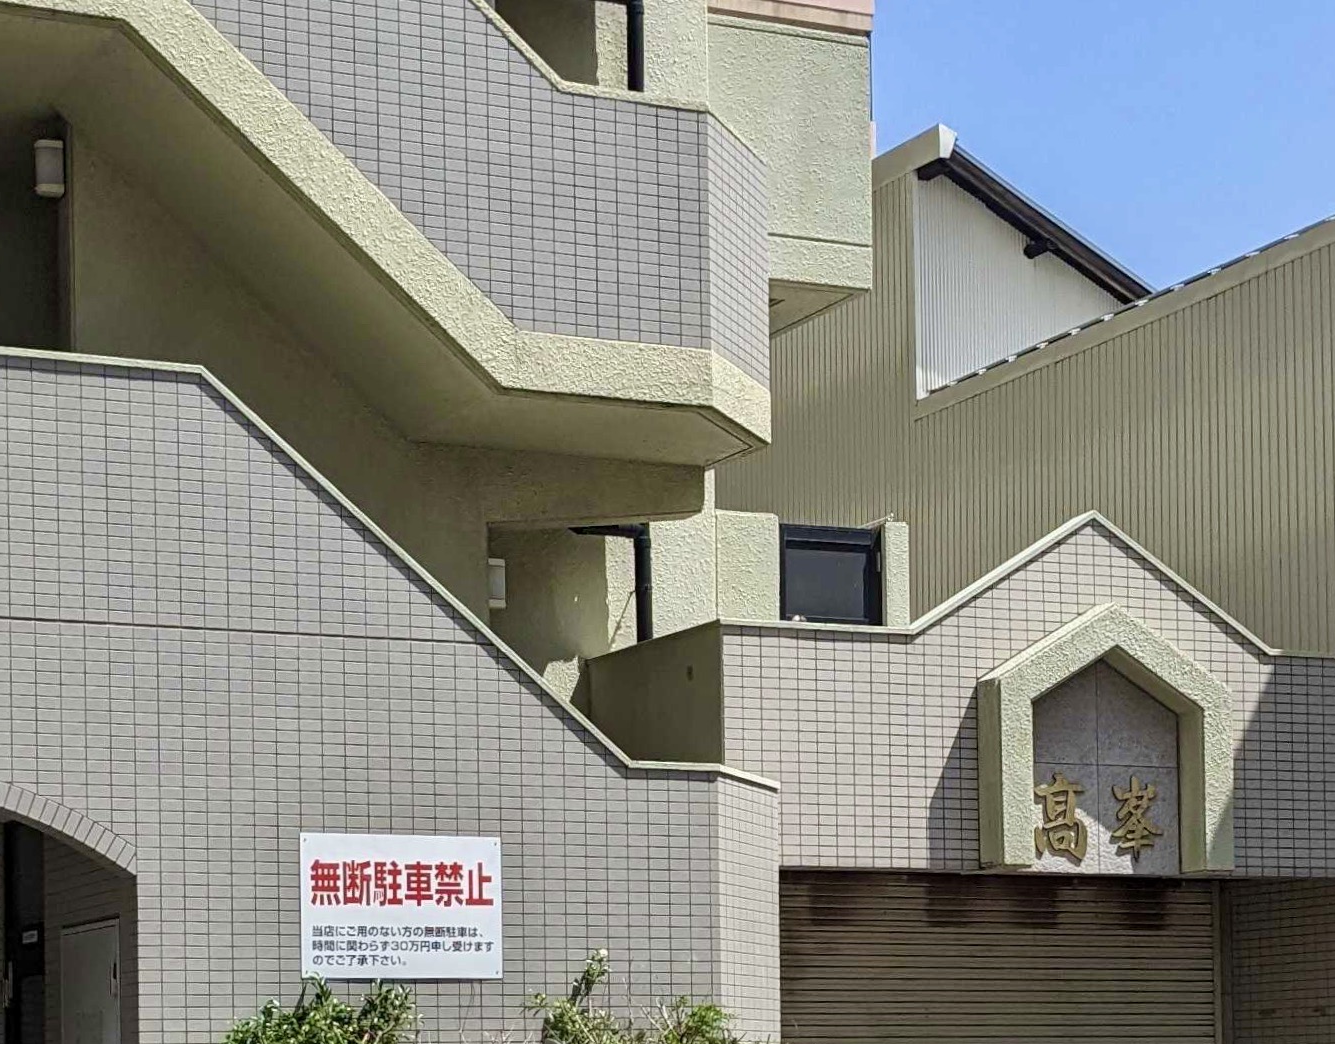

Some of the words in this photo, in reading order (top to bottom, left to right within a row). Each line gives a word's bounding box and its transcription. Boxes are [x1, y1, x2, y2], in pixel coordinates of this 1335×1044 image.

[310, 859, 494, 907] 無断駐車禁止
[312, 953, 408, 967] のでご了承下さい。
